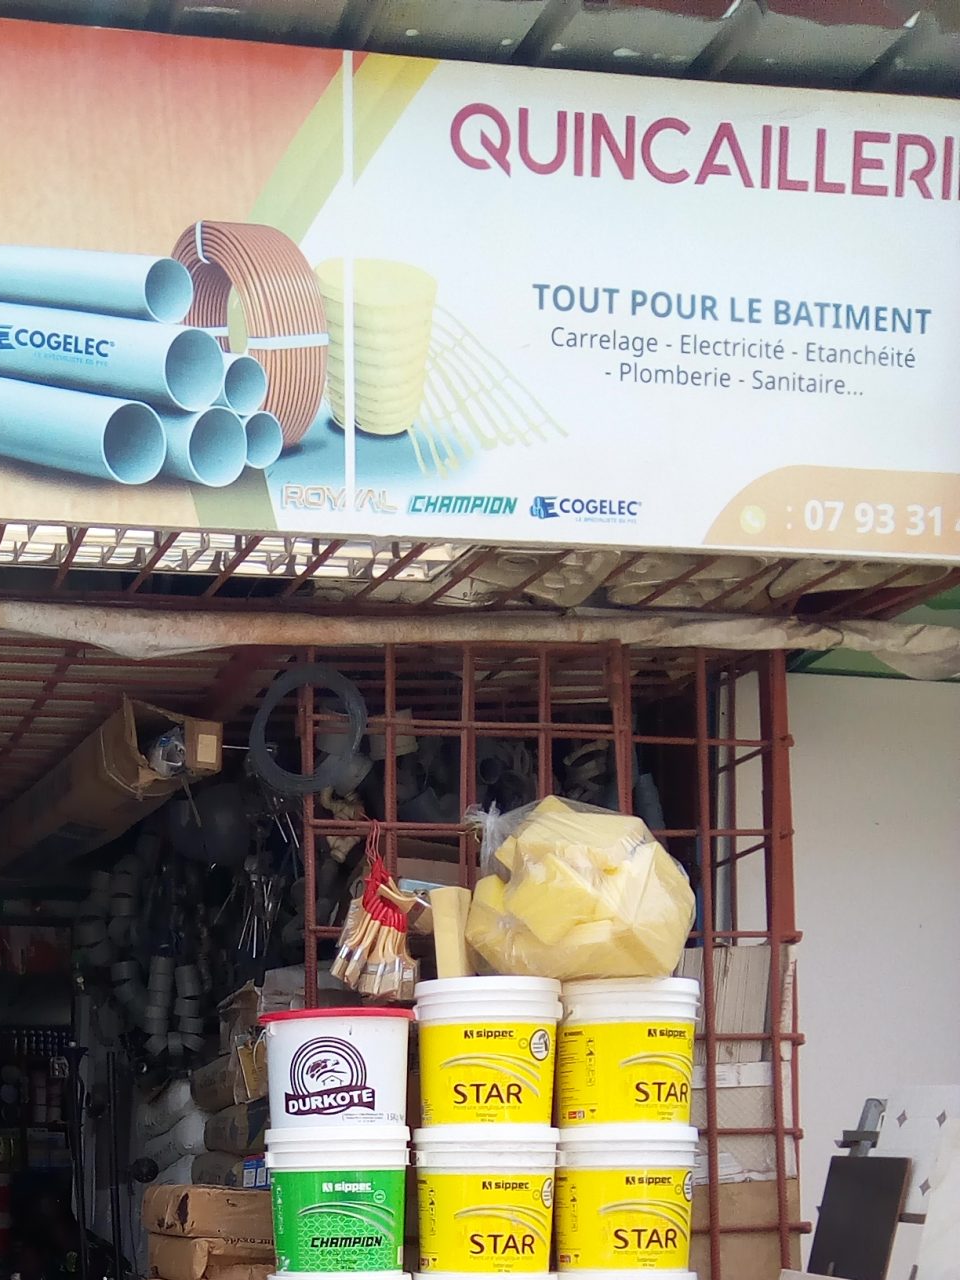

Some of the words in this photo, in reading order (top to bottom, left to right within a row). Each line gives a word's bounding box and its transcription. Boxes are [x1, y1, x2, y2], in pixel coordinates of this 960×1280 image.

[450, 103, 960, 200] QUINCAILLERI
[532, 284, 620, 315] TOUT
[630, 290, 719, 321] POUR
[730, 297, 762, 324] LE
[774, 300, 932, 335] BATIMENT
[15, 328, 109, 357] COGELEC
[551, 327, 658, 358] Carrelage
[680, 334, 784, 361] Electricité
[806, 342, 916, 368] Etanchéité
[620, 363, 731, 388] Plomberie
[409, 495, 518, 515] CHAMPION
[559, 498, 638, 516] COGELEC
[804, 499, 844, 532] 07
[854, 502, 895, 534] 93
[906, 504, 944, 536] 31
[476, 1028, 515, 1039] sippec
[288, 1089, 374, 1113] DURKOTE
[453, 1083, 523, 1105] STAR
[634, 1082, 688, 1103] STAR
[335, 1181, 372, 1193] sippec
[494, 1180, 530, 1191] sippec
[638, 1176, 672, 1186] sippec
[310, 1235, 382, 1248] CHAMPION
[469, 1233, 535, 1255] STAR
[614, 1228, 678, 1250] STAR
